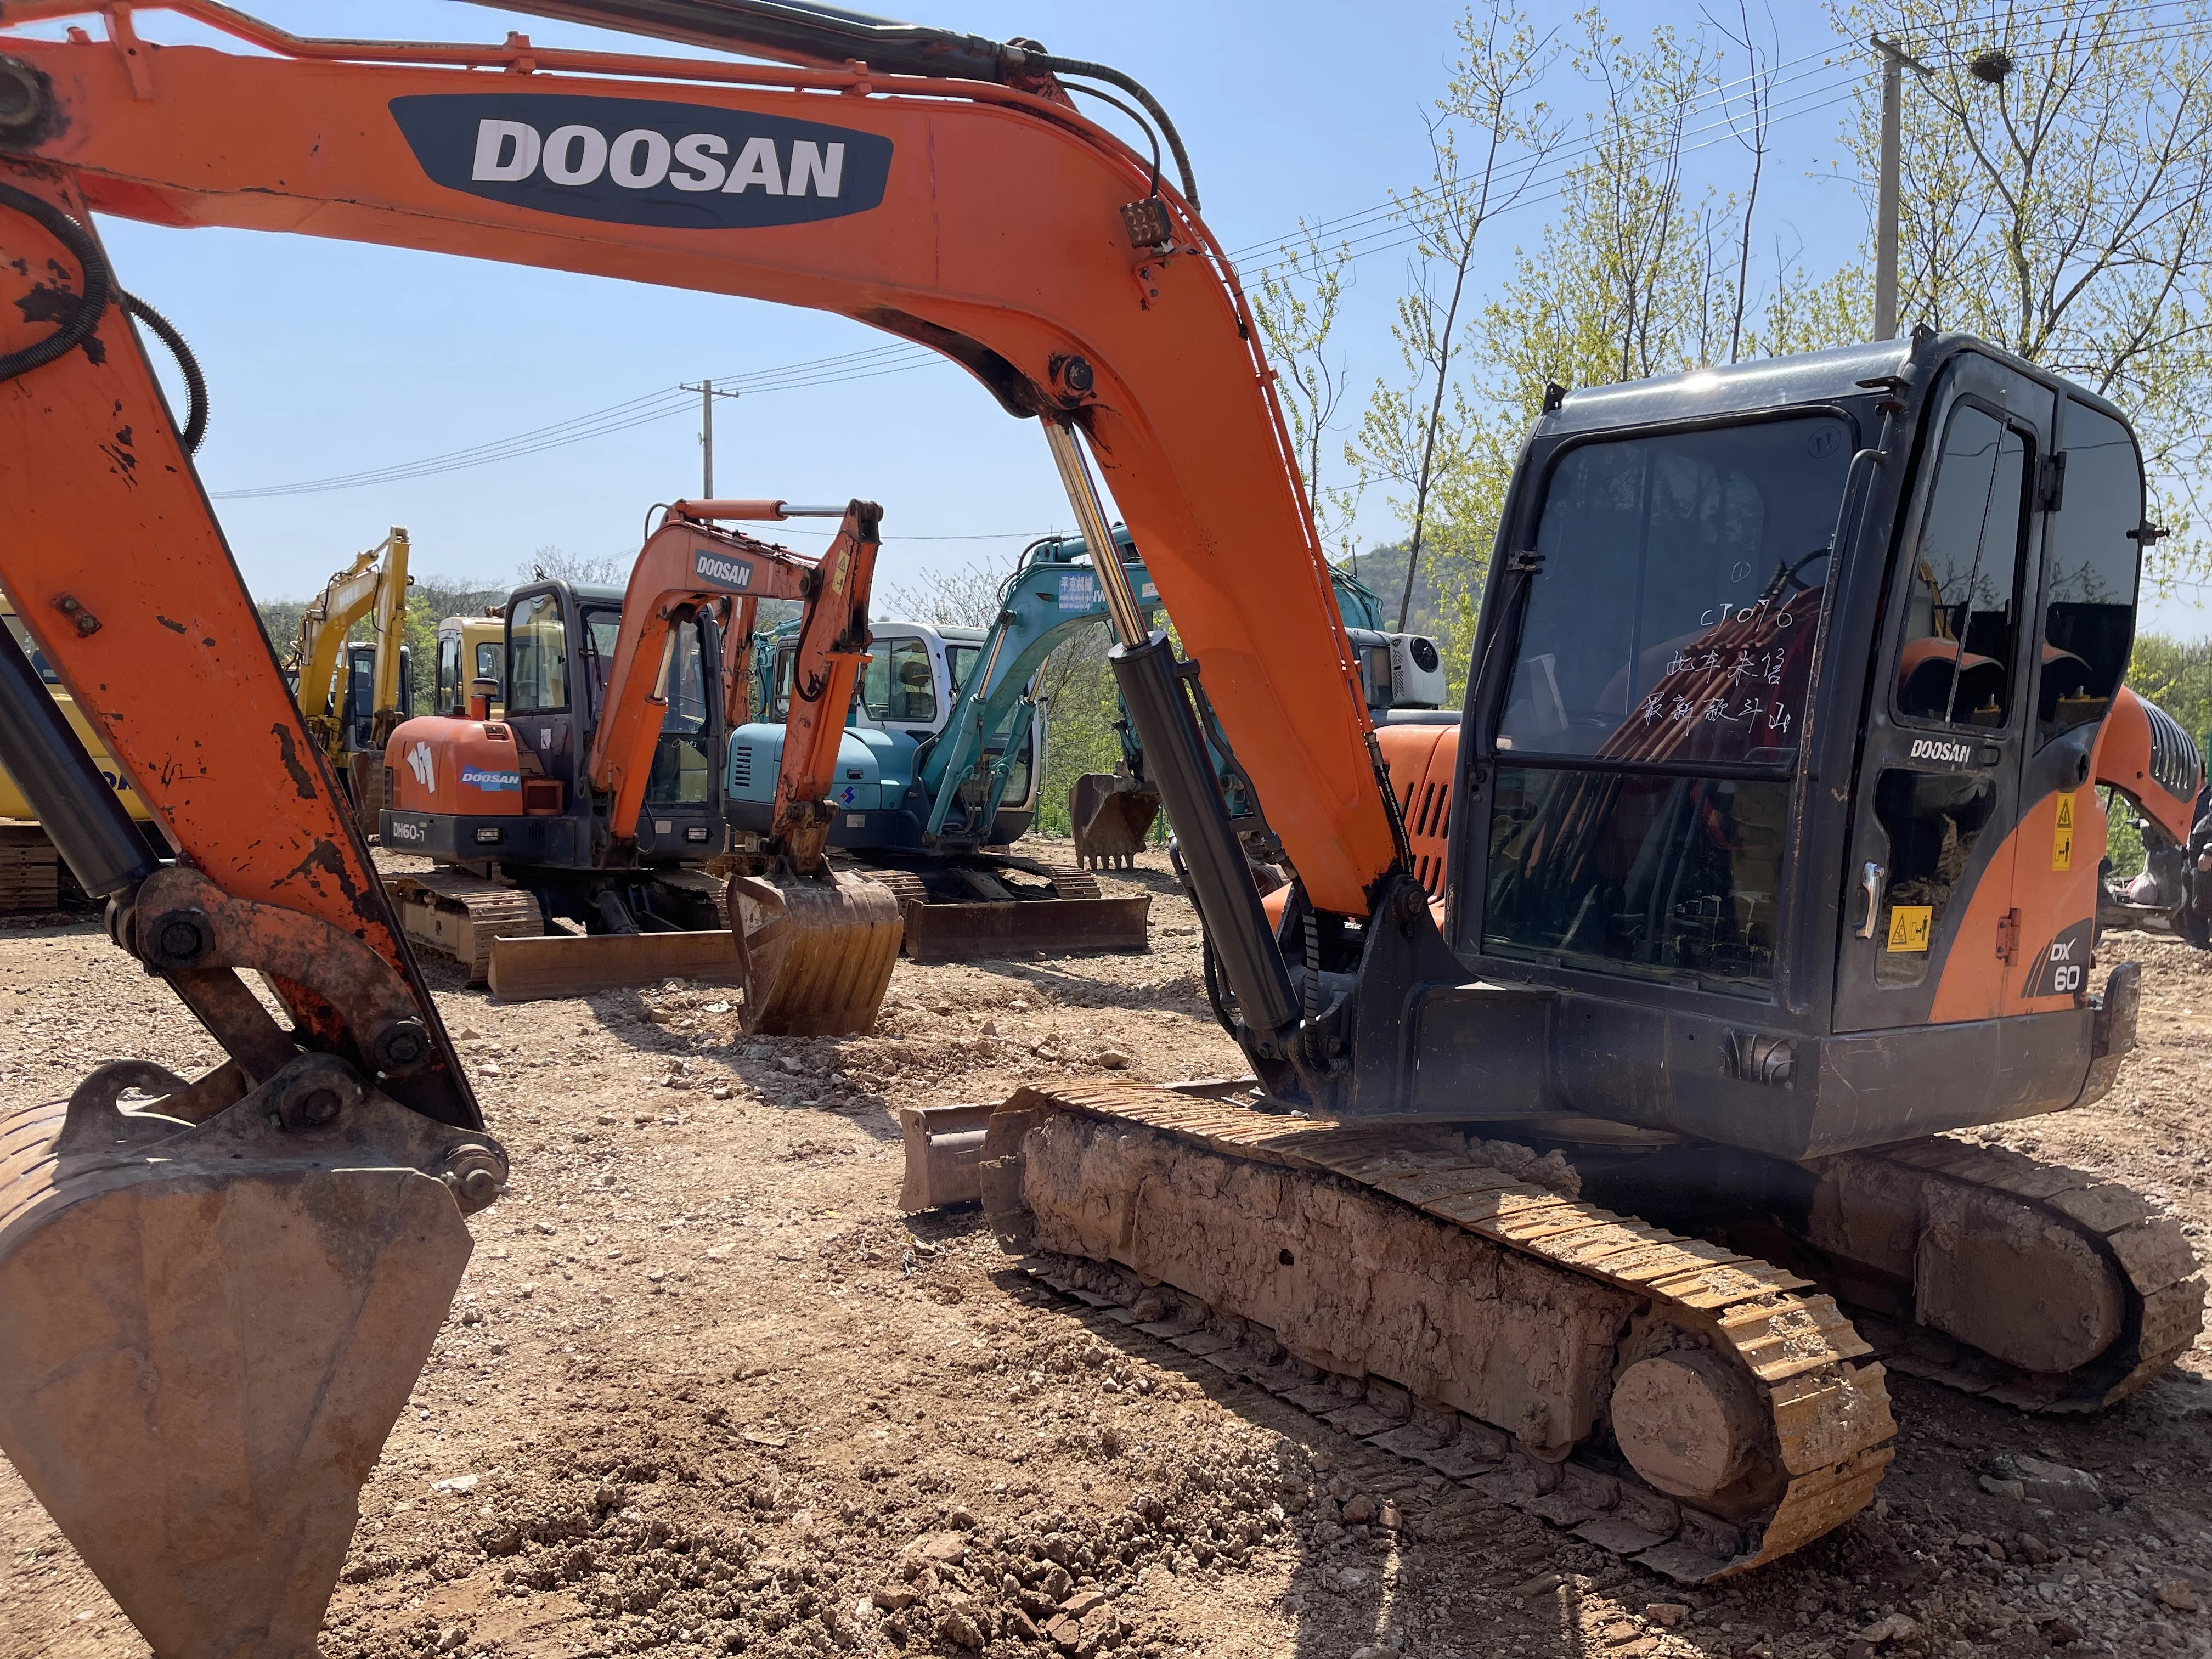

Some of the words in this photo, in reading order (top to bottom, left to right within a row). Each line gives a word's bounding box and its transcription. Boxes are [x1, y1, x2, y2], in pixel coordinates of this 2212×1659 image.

[472, 119, 844, 198] DOOSAN
[697, 556, 751, 586] DOOSAN
[1641, 691, 1792, 737] 最新款斗山
[1910, 739, 1971, 763] DOOSAN
[462, 773, 519, 784] DOOSAN
[393, 822, 425, 842] DH60-7
[2050, 938, 2076, 962] DX
[2054, 965, 2080, 991] 60
